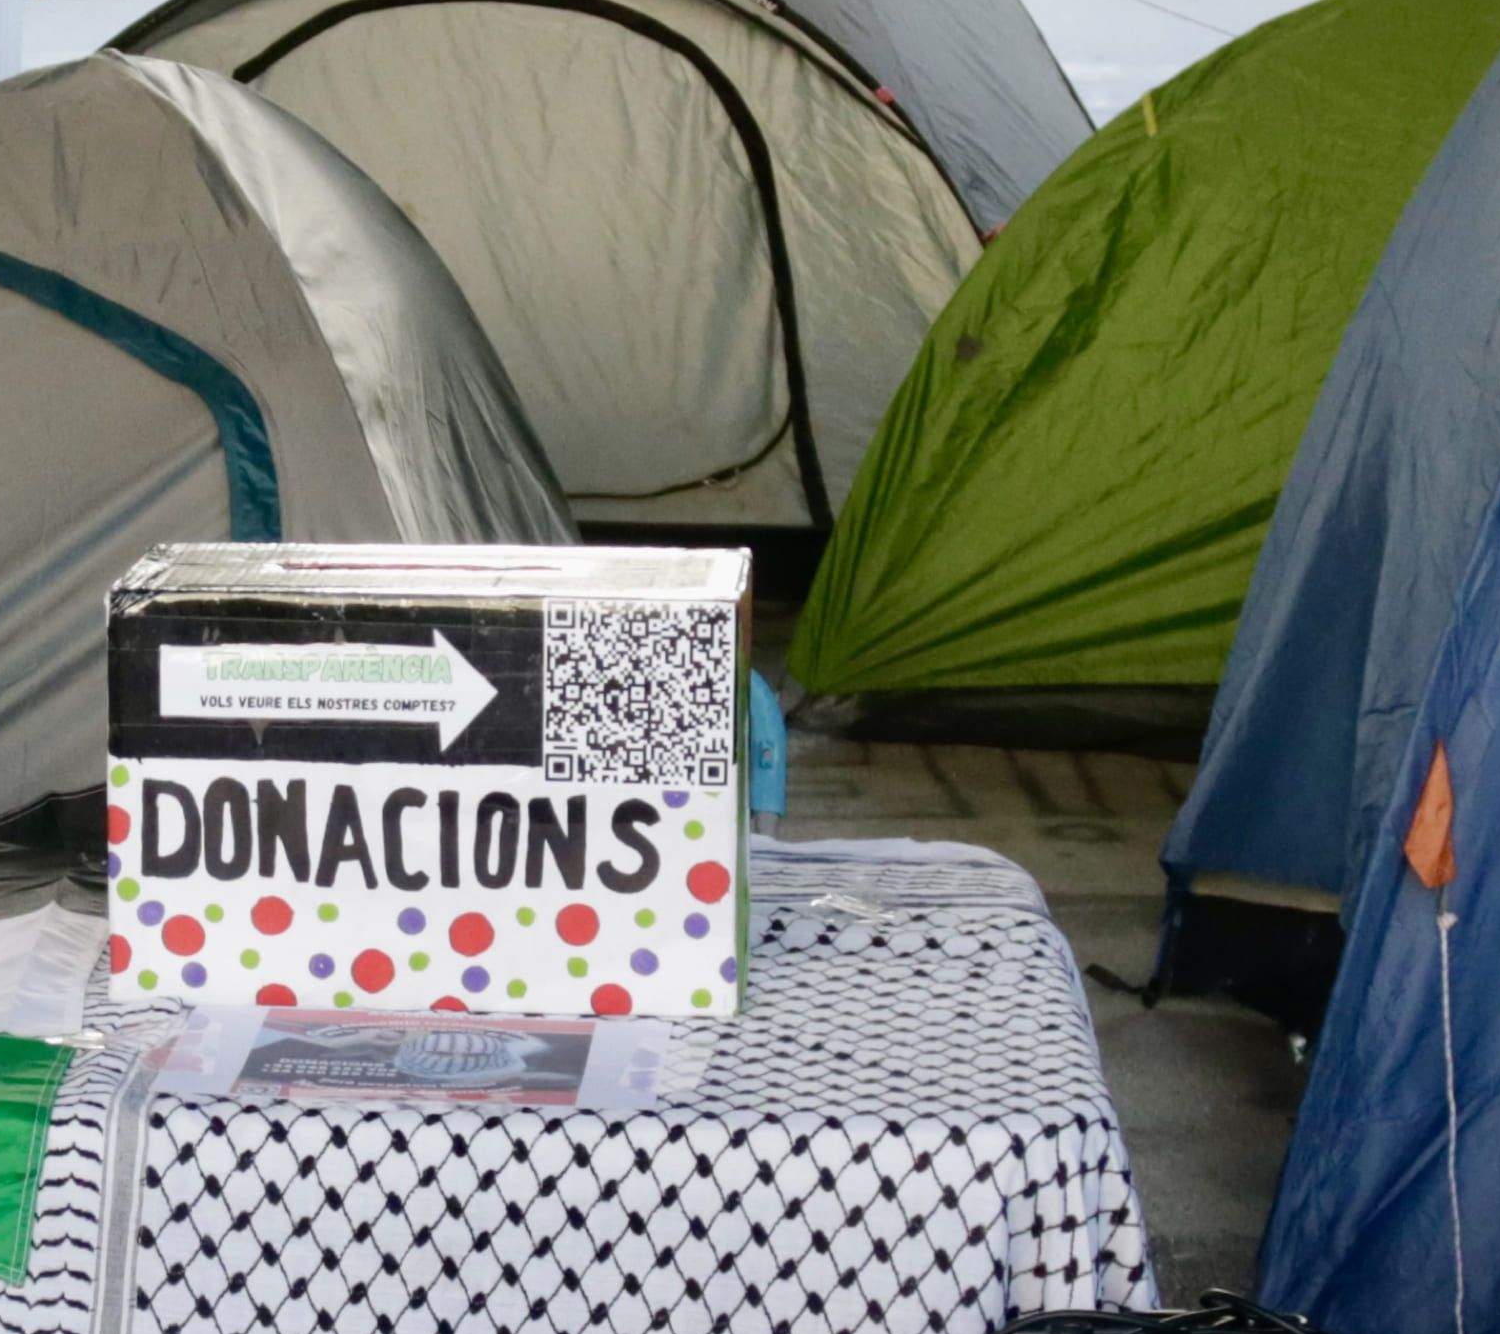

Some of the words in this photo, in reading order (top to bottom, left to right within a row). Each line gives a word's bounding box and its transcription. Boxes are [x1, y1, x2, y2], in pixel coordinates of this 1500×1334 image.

[202, 646, 454, 685] TRANSPARÈNCIA
[200, 695, 232, 709] VOLS
[239, 695, 282, 710] VEURE
[287, 697, 312, 710] ELS
[317, 698, 378, 711] NOSTRES
[383, 699, 456, 713] COMPTES?
[140, 776, 661, 894] DONACIONS
